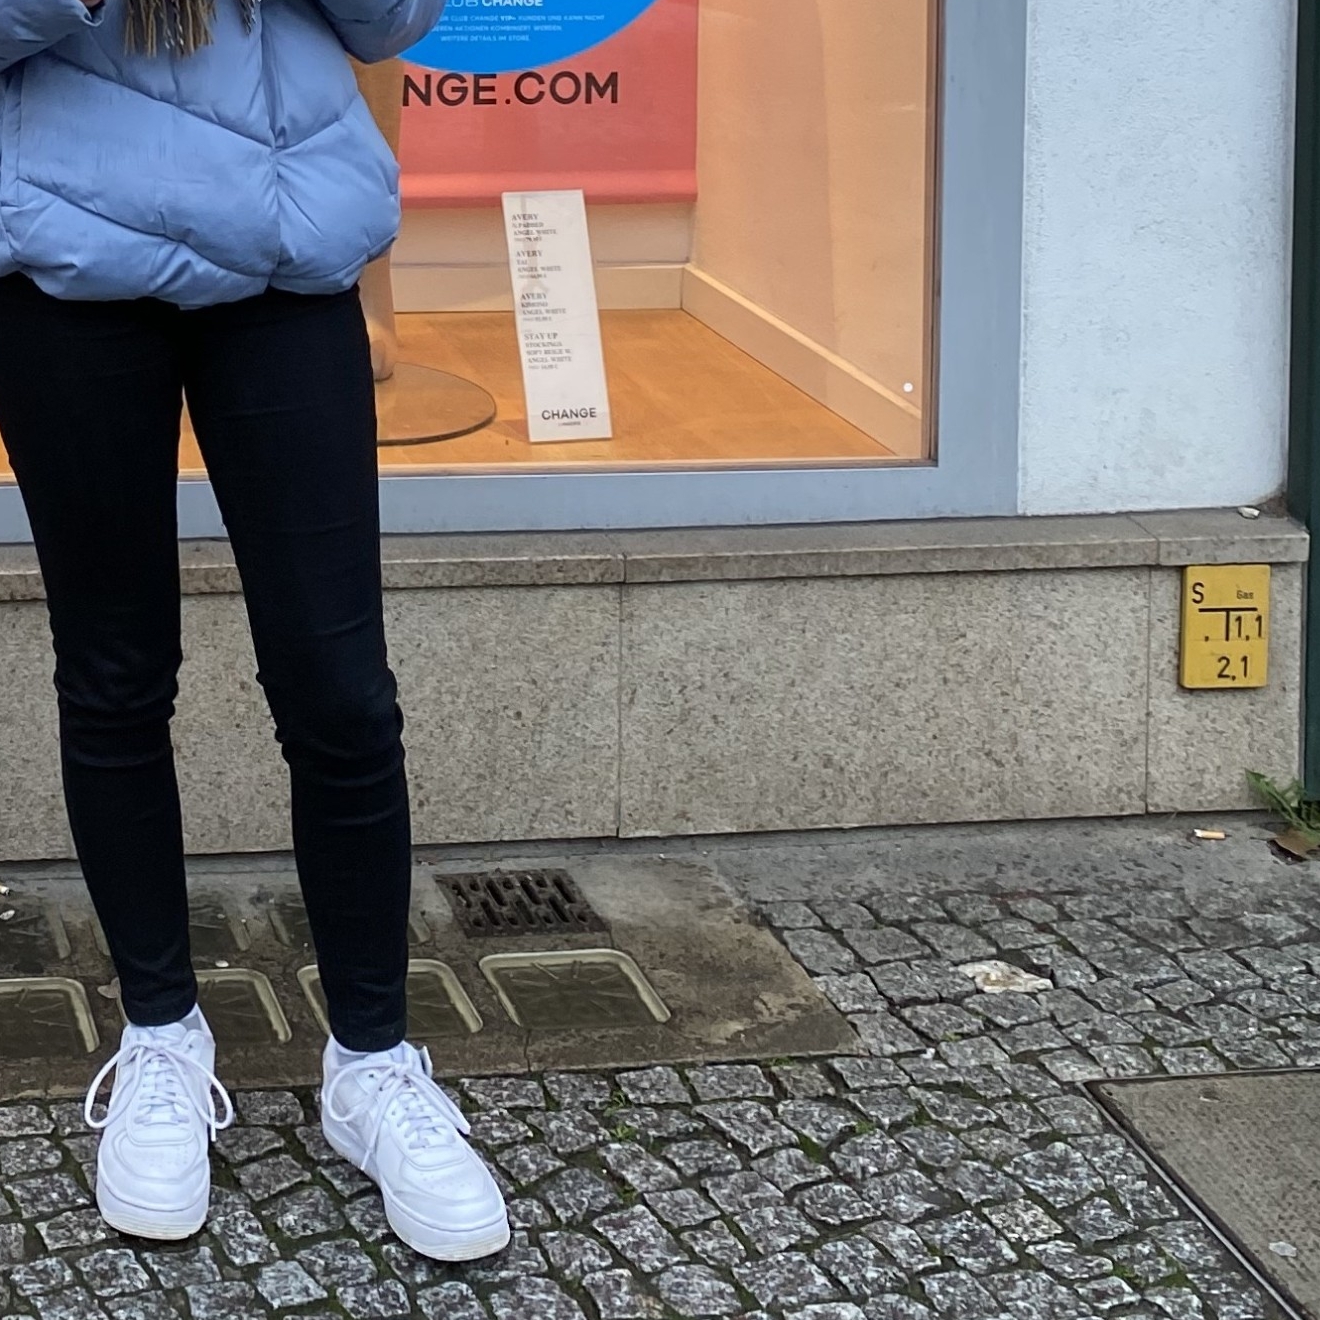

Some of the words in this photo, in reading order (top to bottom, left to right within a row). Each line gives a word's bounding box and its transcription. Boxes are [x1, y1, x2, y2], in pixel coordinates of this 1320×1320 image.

[541, 407, 597, 420] CHANGE
[1192, 582, 1205, 604] S
[1236, 589, 1254, 600] Gas
